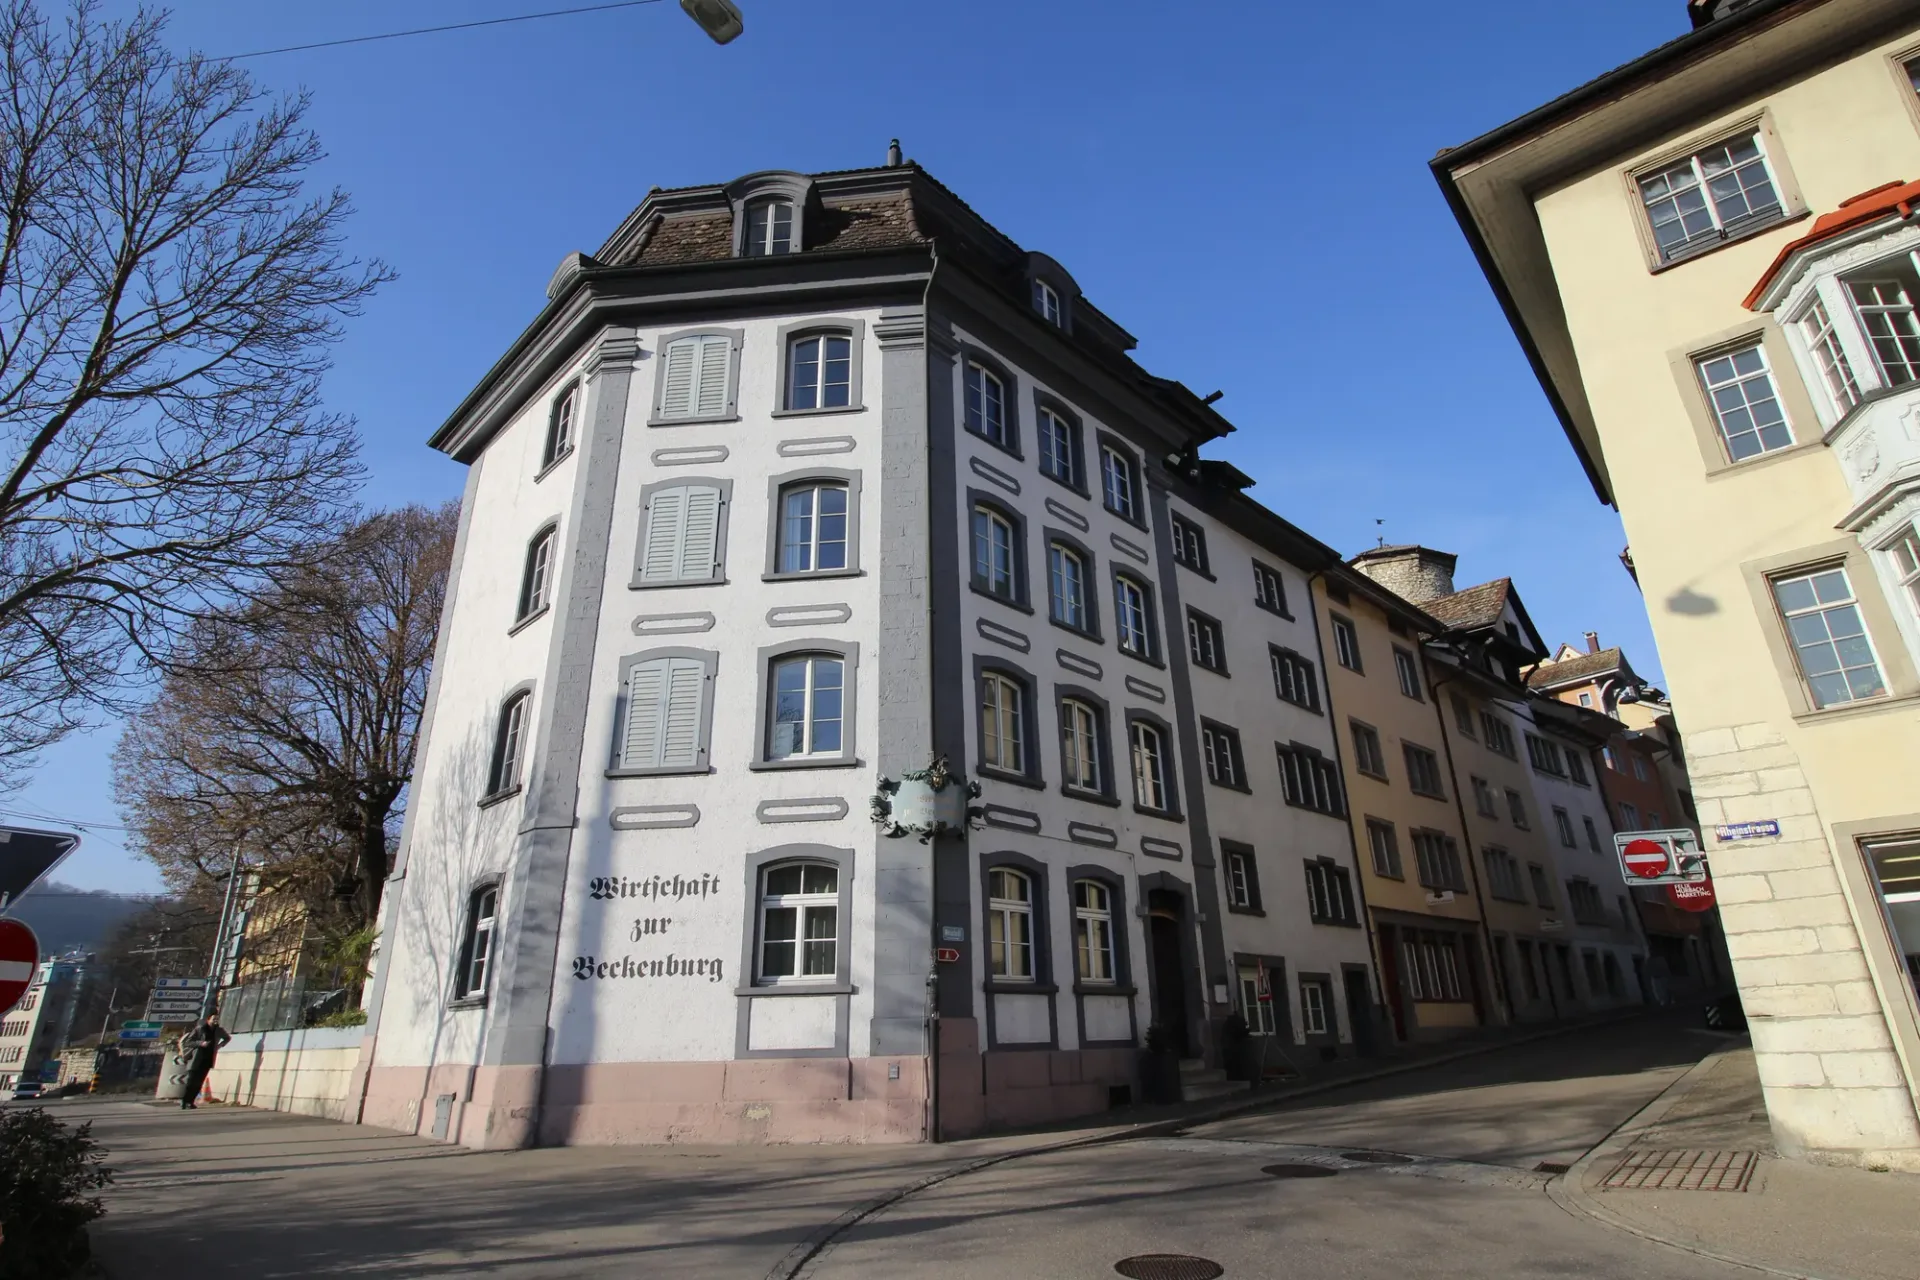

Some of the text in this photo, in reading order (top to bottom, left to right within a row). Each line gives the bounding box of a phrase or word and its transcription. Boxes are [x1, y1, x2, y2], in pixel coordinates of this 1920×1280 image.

[1719, 823, 1776, 837] Rheinstrasse
[589, 873, 720, 903] Wirtschaft
[1677, 890, 1711, 898] MARKETING
[630, 917, 672, 942] zur
[572, 953, 724, 983] Beckenburg
